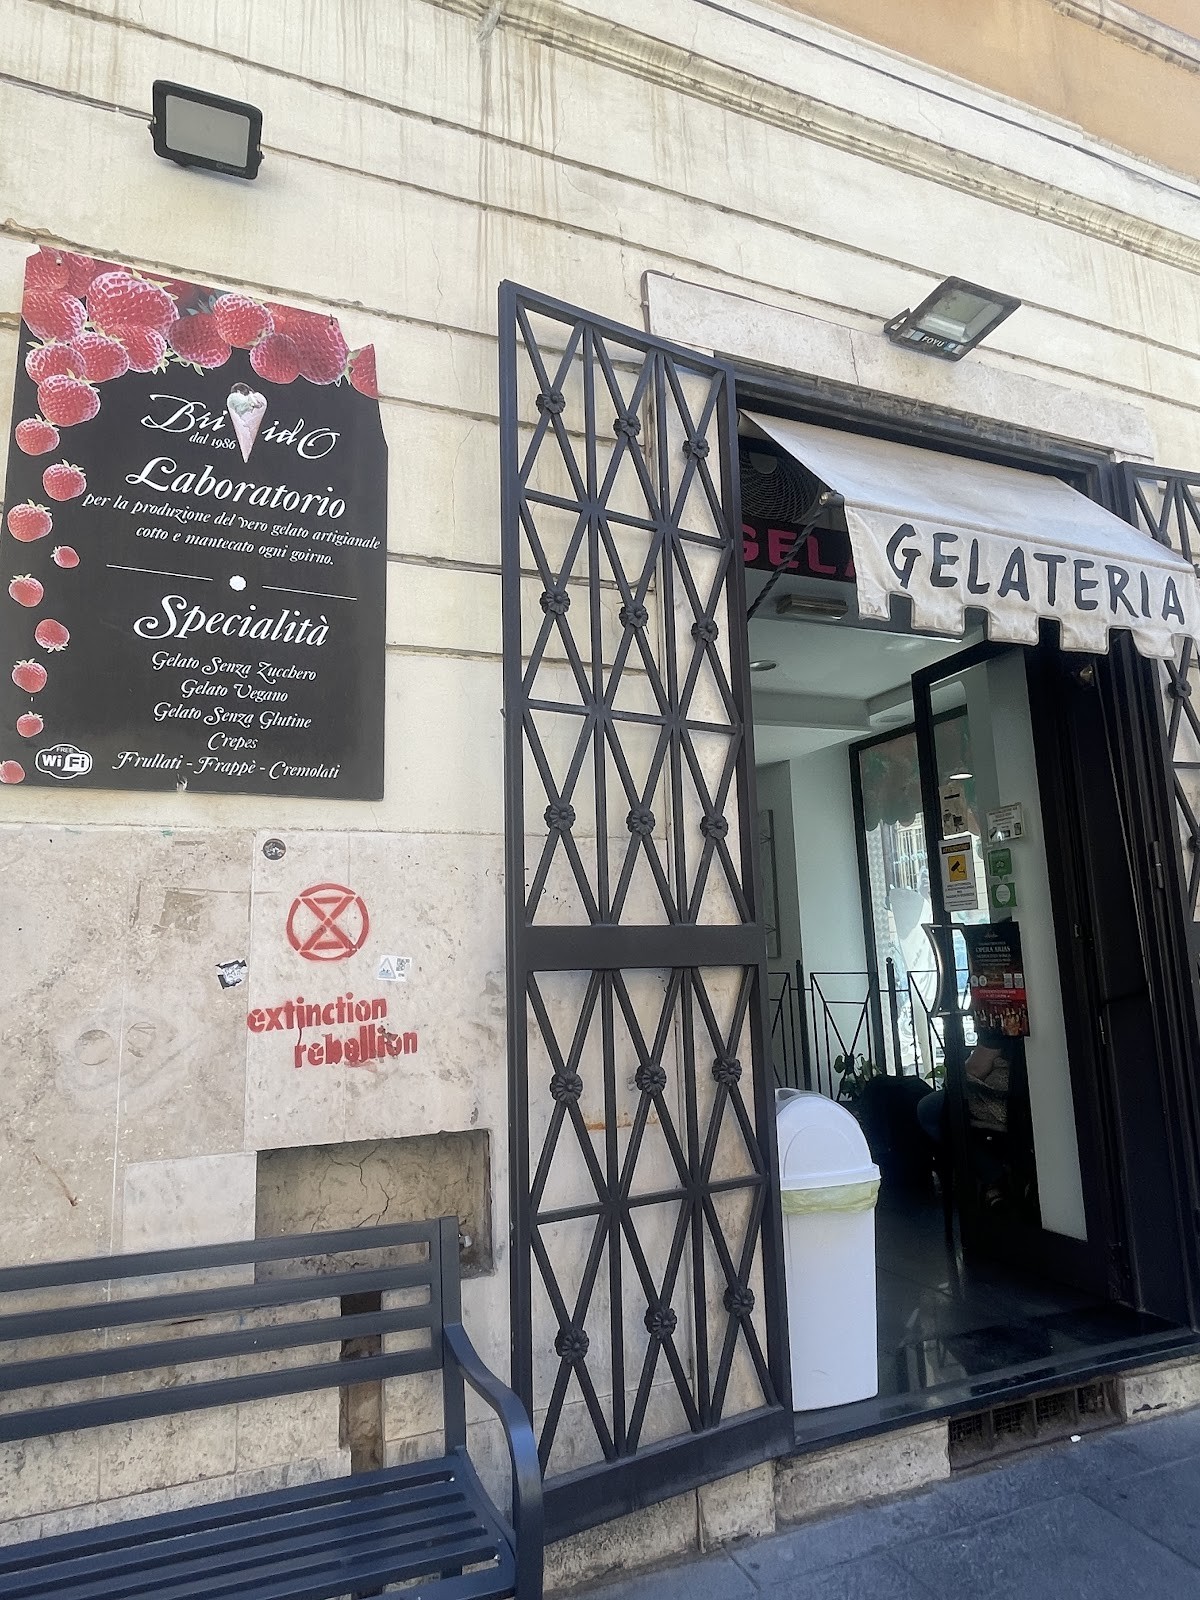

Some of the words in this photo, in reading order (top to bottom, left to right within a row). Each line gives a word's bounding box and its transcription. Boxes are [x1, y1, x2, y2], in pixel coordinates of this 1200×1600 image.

[921, 336, 945, 347] FOYU
[189, 432, 208, 445] dal
[211, 438, 236, 450] 1986
[125, 456, 346, 519] Laboratorio
[82, 493, 111, 507] per
[113, 495, 129, 510] la
[131, 501, 211, 524] produzione
[214, 511, 236, 526] del
[238, 516, 268, 532] vero
[271, 523, 309, 537] gelato
[312, 530, 381, 550] artigianale
[136, 526, 169, 540] cotto
[172, 532, 181, 542] e
[184, 534, 254, 553] mantecato
[258, 545, 289, 559] ogni
[290, 549, 334, 565] goirno.
[742, 523, 855, 577] GEL
[886, 523, 1186, 625] GELATERIA
[133, 594, 330, 647] Specialità
[151, 651, 200, 671] Gelato
[201, 656, 252, 676] Senza
[256, 661, 317, 685] Zucchero
[180, 679, 228, 698] Gelato
[233, 683, 289, 703] Vegano
[153, 702, 202, 722] Gelato
[203, 706, 254, 728] Senza
[259, 711, 312, 729] Glutine
[207, 732, 258, 750] Crepes
[112, 751, 184, 771] Frullati
[193, 757, 256, 775] Frappè
[268, 761, 341, 780] Cremolati
[247, 992, 388, 1033] extinction
[294, 1024, 418, 1067] rebellion
